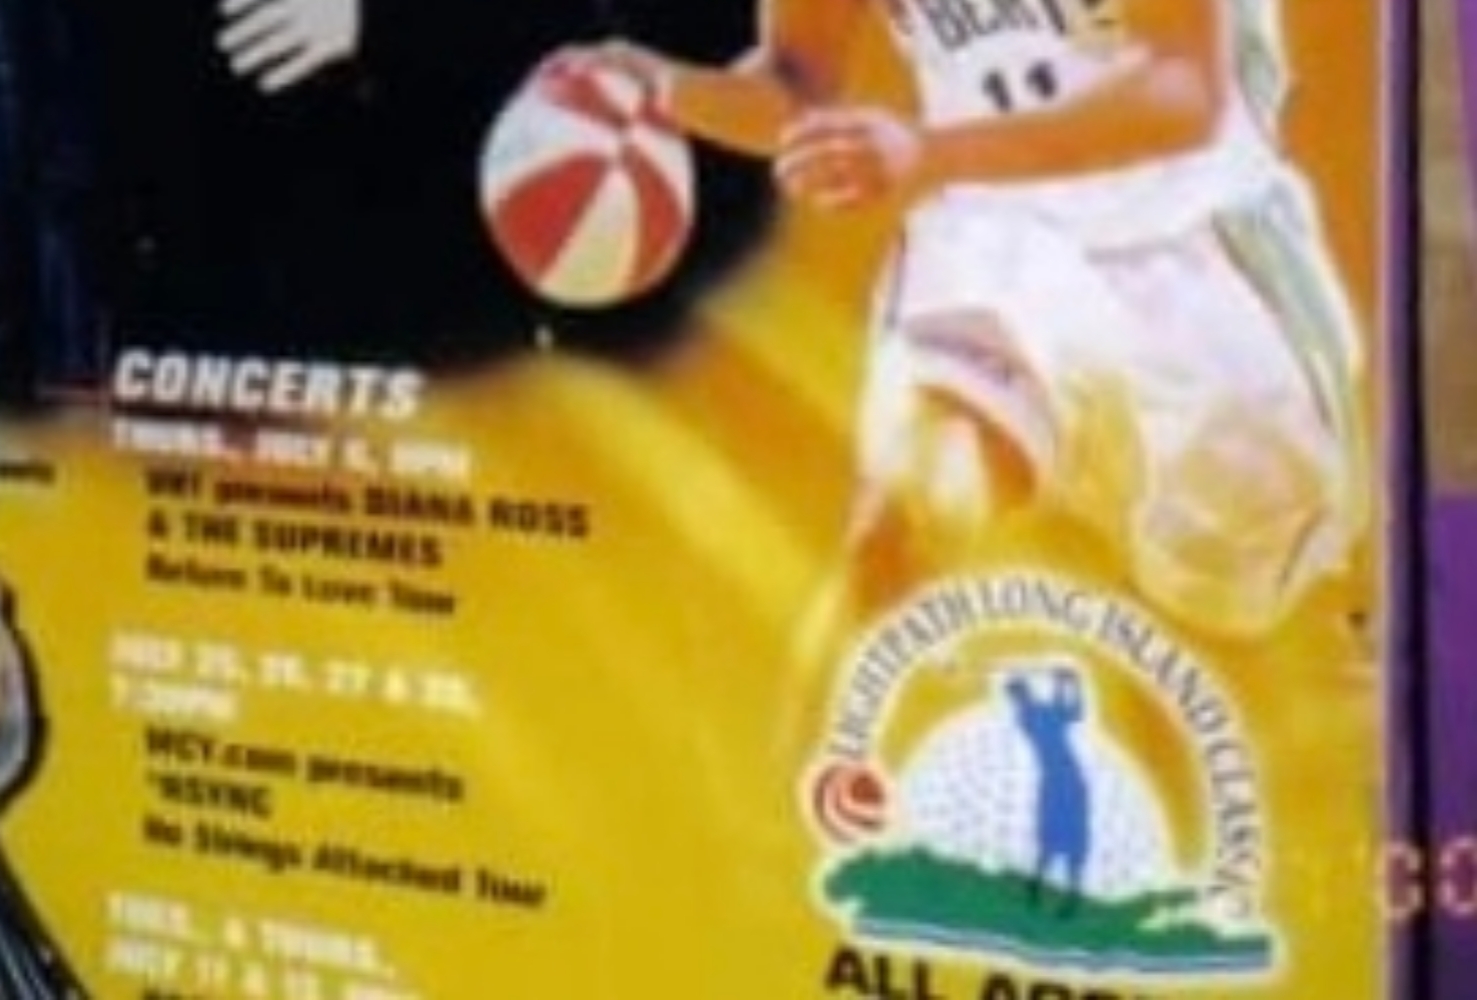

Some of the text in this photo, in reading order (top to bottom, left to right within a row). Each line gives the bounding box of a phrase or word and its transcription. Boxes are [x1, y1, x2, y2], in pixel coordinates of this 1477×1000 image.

[113, 346, 423, 419] CONCERTS
[214, 481, 351, 514] presents
[363, 486, 474, 526] DIANA
[489, 496, 591, 538] ROSS
[183, 511, 239, 546] THE
[252, 519, 442, 569] SUPREMES
[145, 553, 246, 590] Return
[302, 574, 376, 607] Love
[979, 575, 1092, 631] LONG
[1098, 600, 1230, 736] ISLAND
[306, 755, 465, 801] presents
[143, 814, 547, 907] No Strings Attached Tour
[825, 945, 943, 1000] ALL
